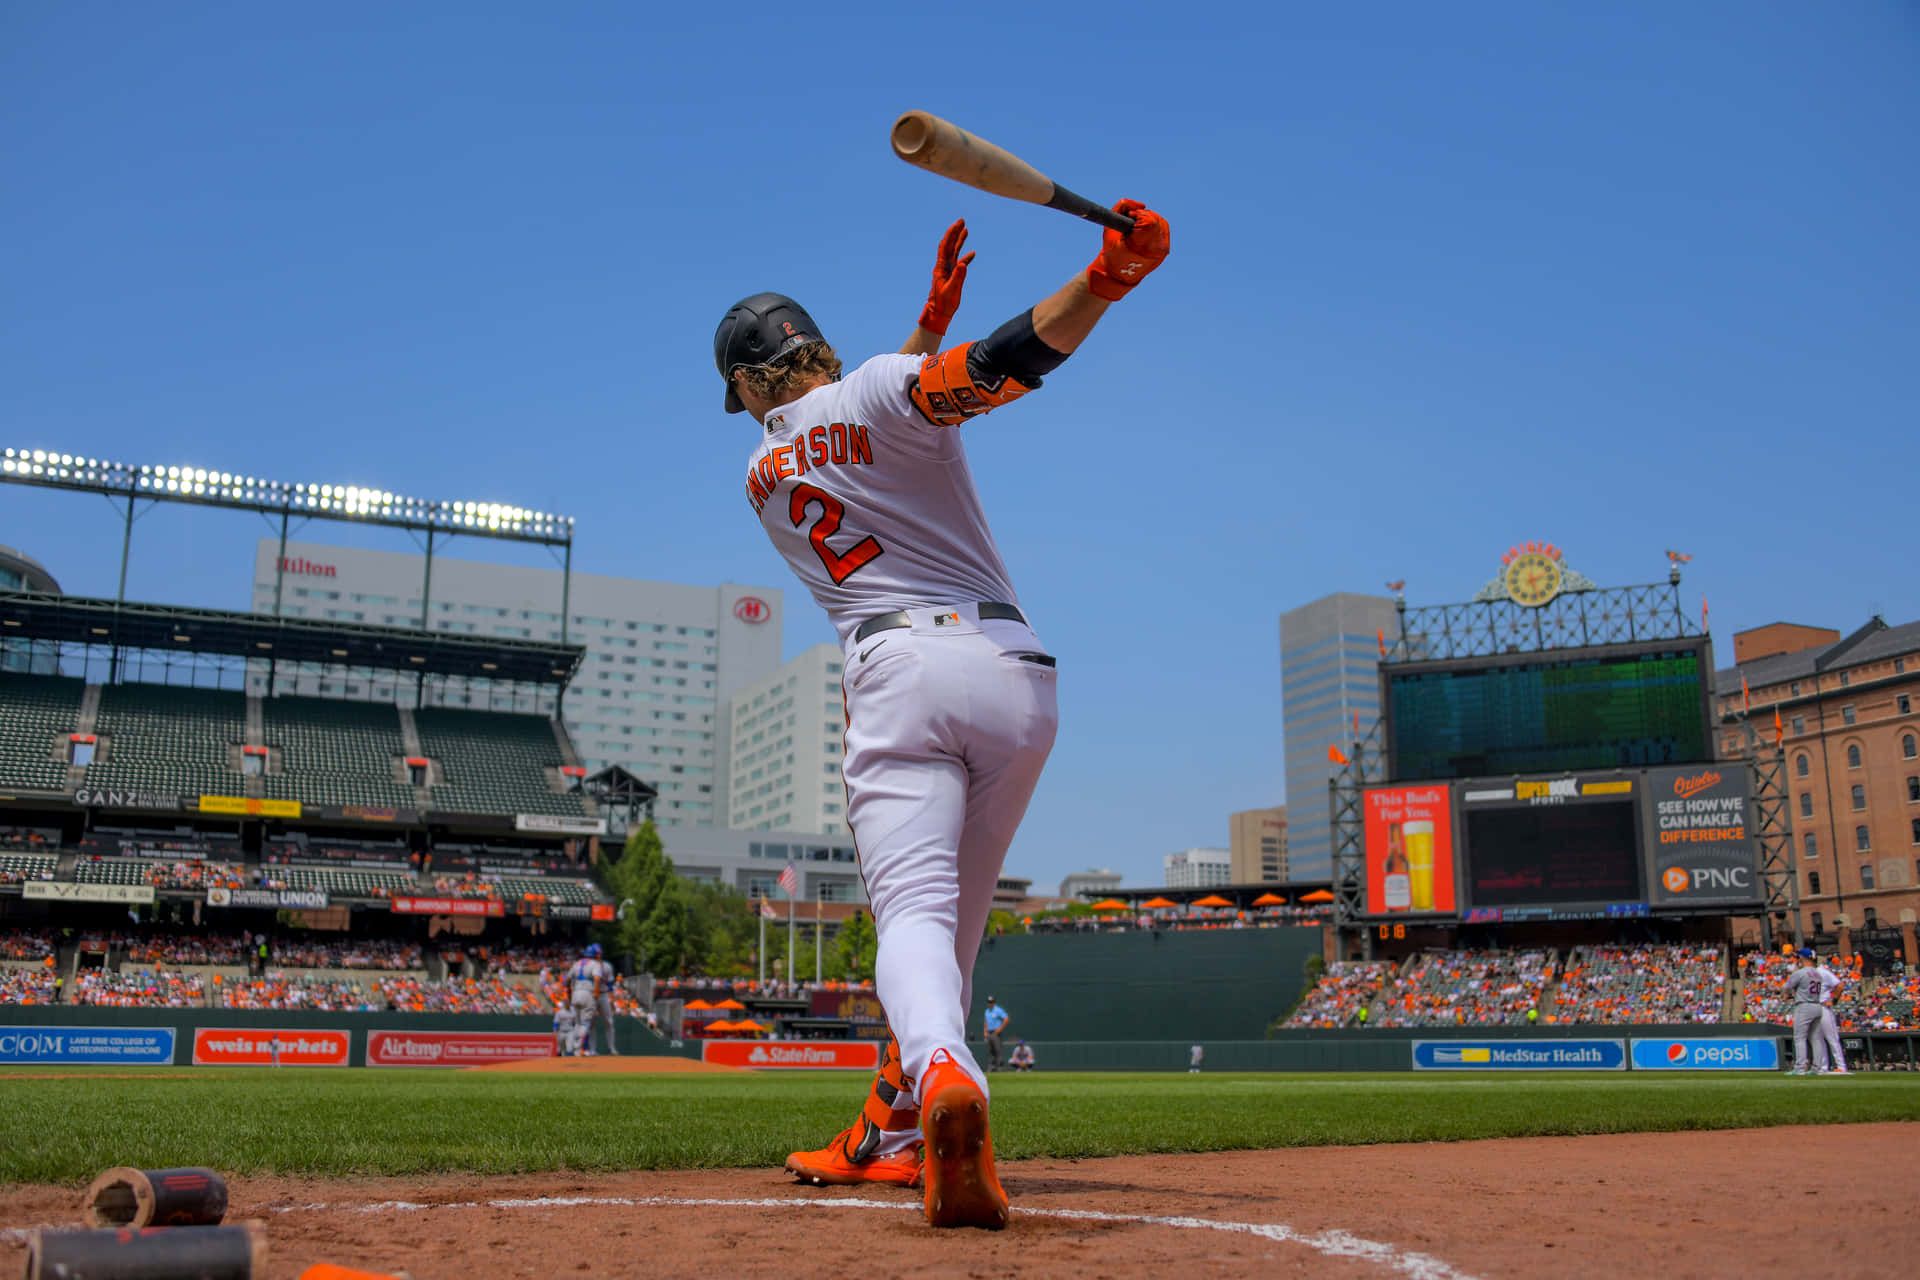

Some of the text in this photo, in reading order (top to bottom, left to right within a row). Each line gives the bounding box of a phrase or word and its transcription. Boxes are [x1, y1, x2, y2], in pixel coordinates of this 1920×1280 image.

[783, 322, 796, 335] 2
[746, 423, 873, 520] NDERSON
[789, 483, 885, 587] 2
[277, 558, 336, 577] Hilton
[1674, 771, 1722, 798] Orioles
[75, 789, 137, 807] GANZ
[1371, 793, 1403, 806] This
[1658, 797, 1743, 814] SEE HOW WE
[1380, 808, 1401, 821] For
[1660, 812, 1743, 829] CAN MAKE A
[1661, 827, 1744, 844] DIFFERENCE
[1691, 867, 1749, 889] PNC
[280, 891, 327, 906] UNION
[1809, 981, 1822, 995] 20
[207, 1038, 253, 1053] weis
[381, 1037, 442, 1058] Airtemp
[1694, 1044, 1750, 1064] pepsi
[769, 1047, 837, 1063] State Farm
[1492, 1048, 1603, 1063] MedStar Health
